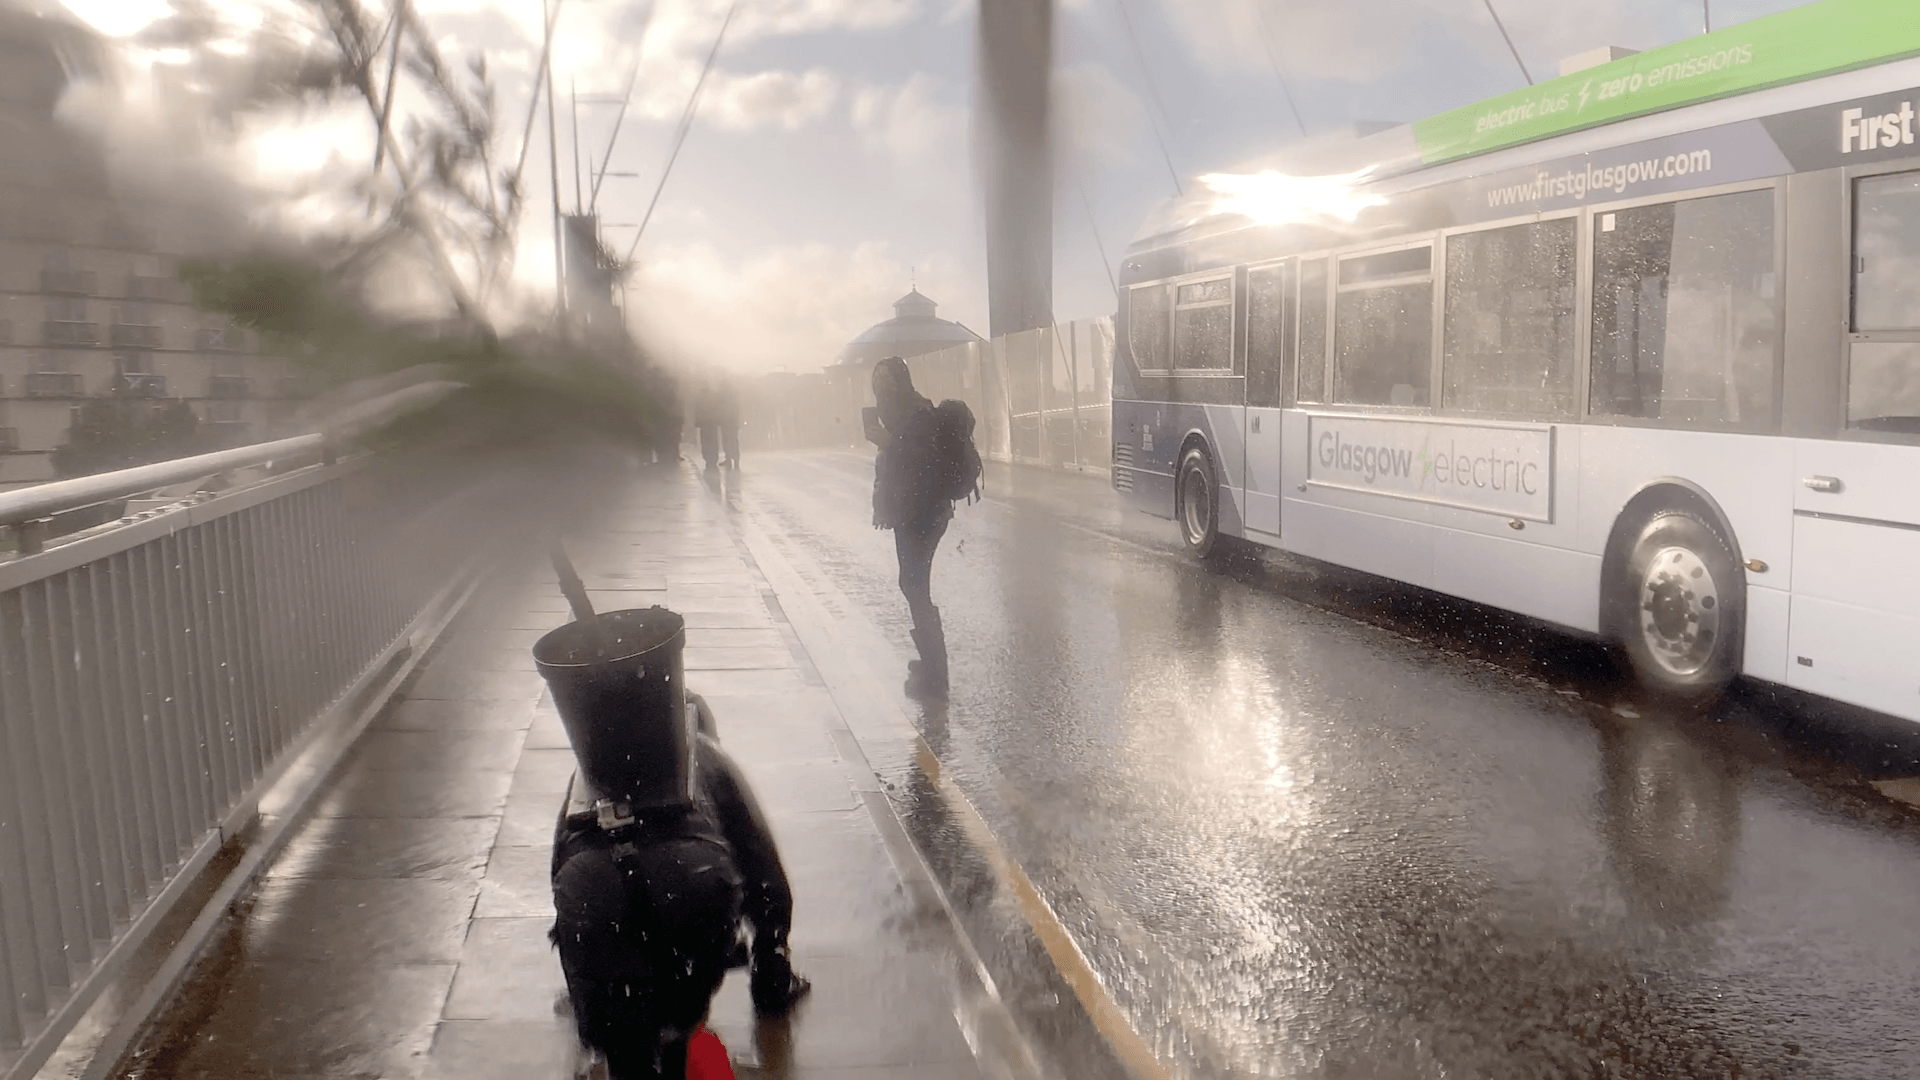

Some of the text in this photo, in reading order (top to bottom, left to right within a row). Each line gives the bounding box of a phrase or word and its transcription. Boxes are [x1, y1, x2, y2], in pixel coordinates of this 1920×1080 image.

[1476, 43, 1752, 132] electric bus zero emissions
[1842, 101, 1914, 154] First
[1488, 149, 1711, 207] www.firstglasgow.com
[1318, 431, 1538, 496] Glasgow electric
